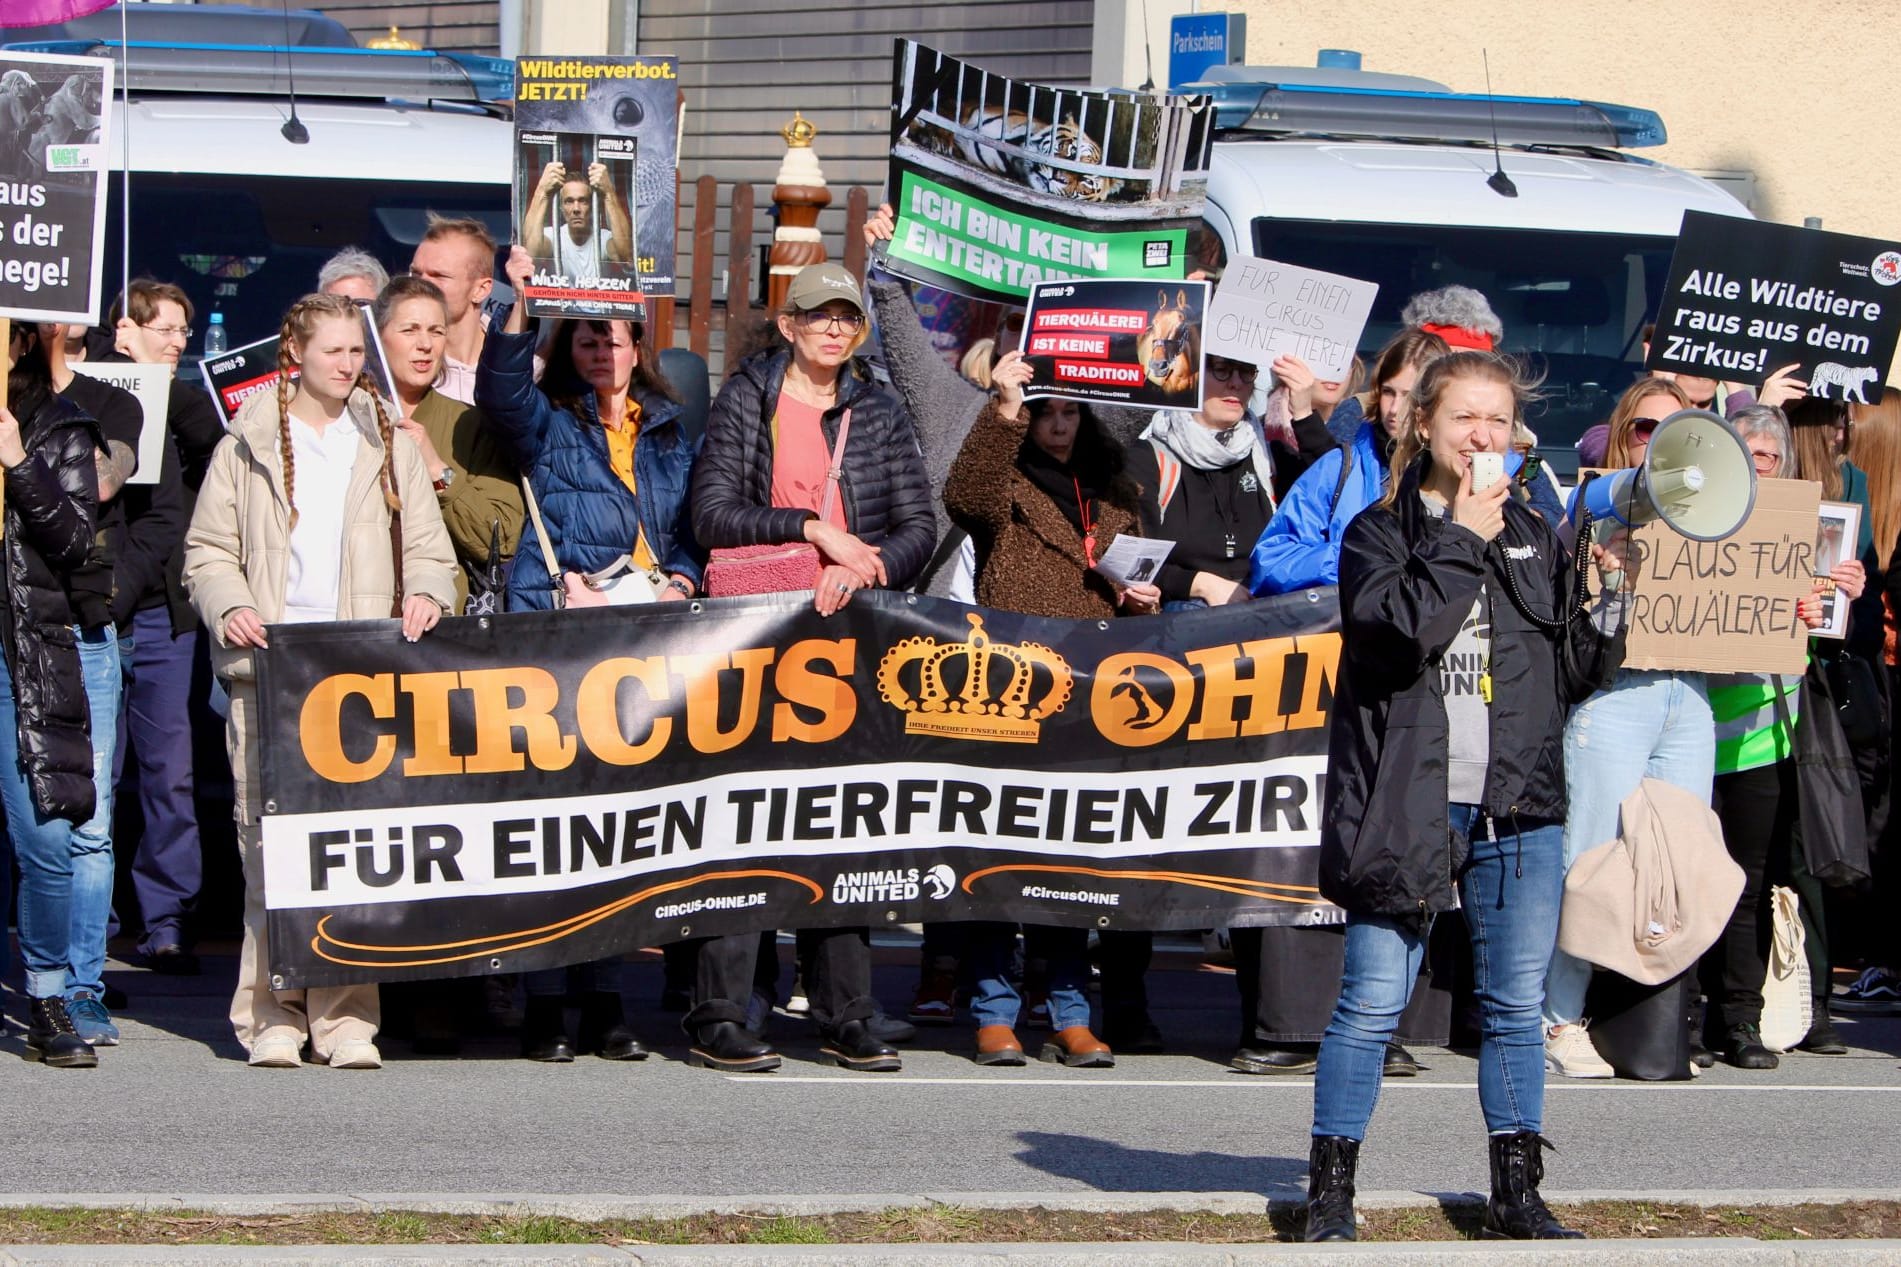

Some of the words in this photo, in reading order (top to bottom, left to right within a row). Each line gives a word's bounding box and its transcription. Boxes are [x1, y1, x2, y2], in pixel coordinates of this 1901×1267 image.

[1173, 28, 1223, 54] Parkschein
[520, 60, 677, 79] Wildtierverbot.
[519, 82, 588, 101] JETZT!
[13, 213, 64, 247] der
[911, 185, 962, 231] ICH
[967, 207, 1022, 252] BIN
[1028, 228, 1109, 271] KEIN
[904, 221, 1096, 289] ENTERTA
[531, 268, 570, 288] WILDE
[575, 274, 631, 291] HERZEN
[1295, 278, 1353, 314] EINEN
[1680, 269, 1741, 300] Alle
[1751, 278, 1881, 321] Wildtiere
[1039, 311, 1143, 329] TIERQUÄLEREI
[1265, 301, 1324, 330] CIRCUS
[1033, 338, 1057, 350] IST
[1059, 339, 1105, 353] KEINE
[1216, 313, 1286, 352] OHNE
[1292, 330, 1350, 372] TIERE!
[1674, 308, 1741, 334] raus
[1747, 319, 1799, 342] aus
[1806, 323, 1870, 355] dem
[1663, 335, 1768, 373] Zirkus!
[1059, 364, 1139, 381] TRADITION
[1750, 533, 1813, 580] FÜR
[299, 637, 857, 783] CIRCUS
[931, 724, 969, 732] FREIHEIT
[308, 823, 465, 891] FÜR
[493, 795, 707, 879] EINEN
[728, 779, 1169, 844] TIERFREIEN
[833, 868, 919, 887] ANIMALS
[655, 892, 767, 919] CIRCUS-OHNE.DE
[832, 882, 919, 903] UNITED
[1022, 885, 1120, 906] #CircusOHNE
